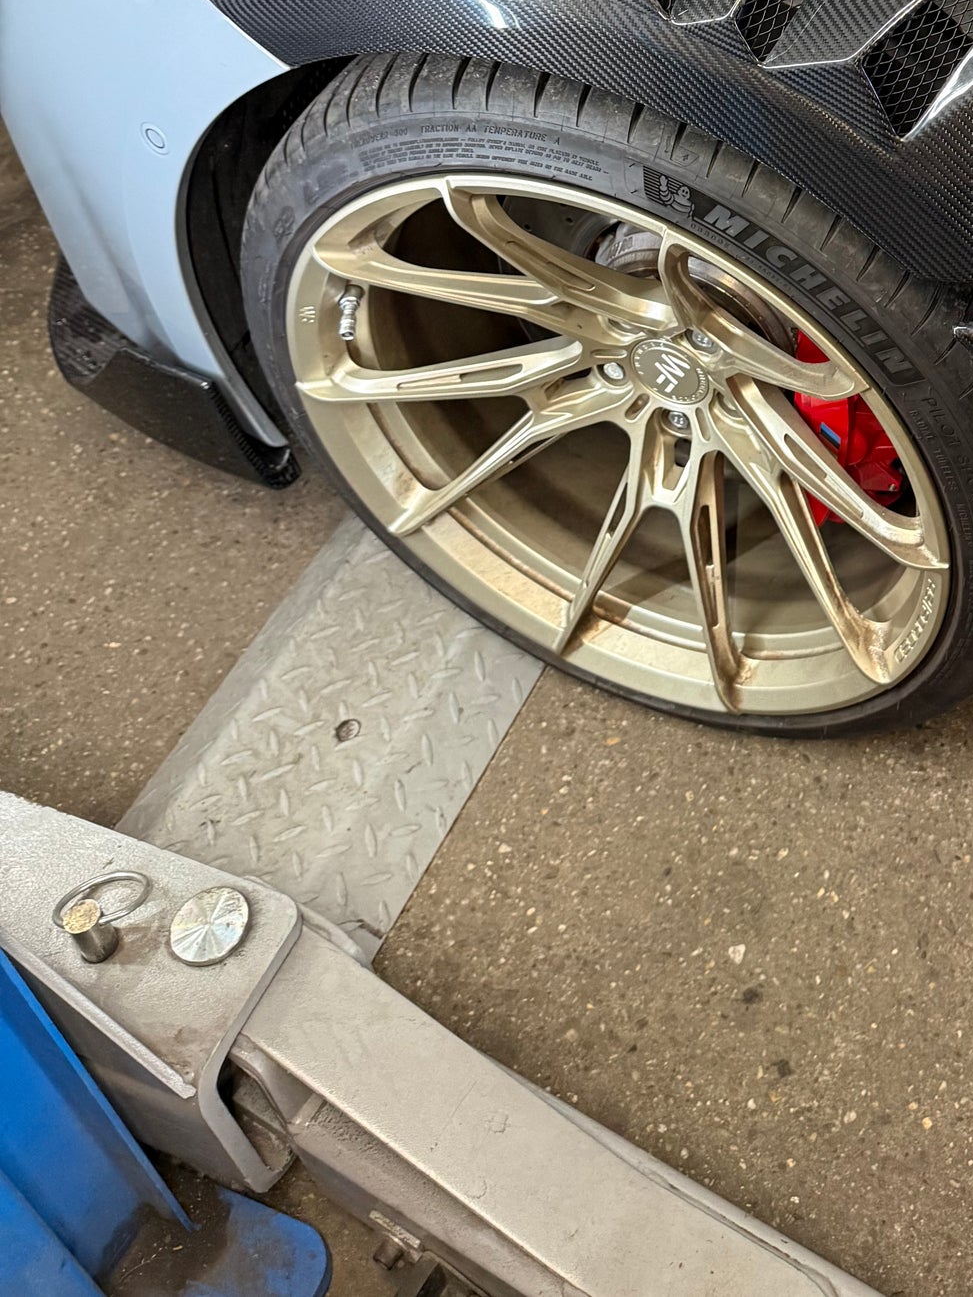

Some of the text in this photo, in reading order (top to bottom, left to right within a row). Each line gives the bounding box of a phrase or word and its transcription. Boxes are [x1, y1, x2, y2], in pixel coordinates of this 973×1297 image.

[420, 125, 459, 134] TRACTION
[467, 125, 477, 133] AA
[484, 125, 548, 142] TEMPERATURE
[703, 204, 913, 373] MICHELIN
[921, 397, 961, 446] PILOT
